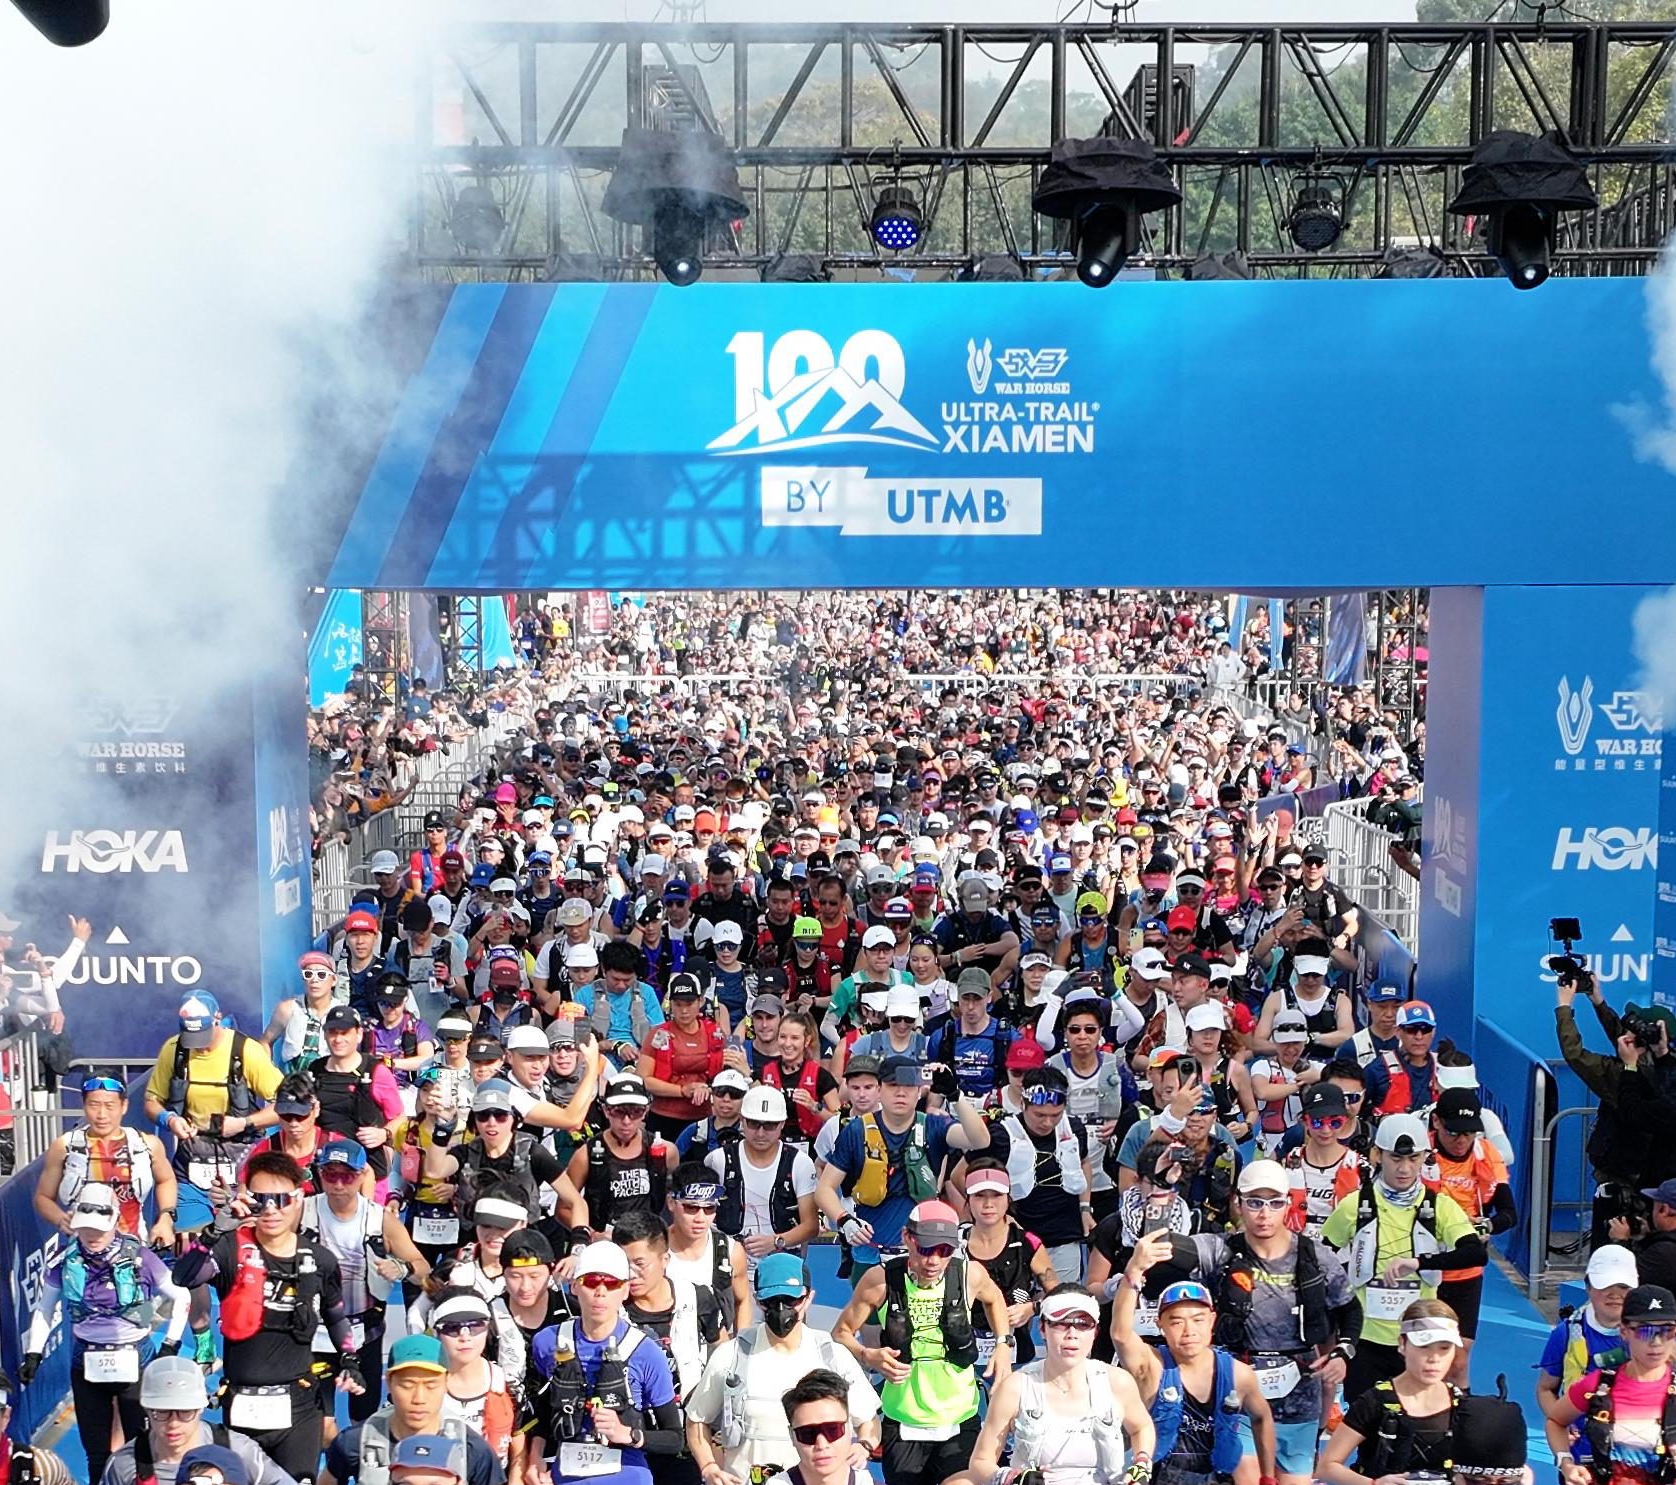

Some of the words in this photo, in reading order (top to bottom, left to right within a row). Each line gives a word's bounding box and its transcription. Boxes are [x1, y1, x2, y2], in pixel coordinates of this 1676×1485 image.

[994, 383, 1023, 395] WAR
[1025, 382, 1071, 395] HORSE
[942, 424, 1095, 453] XIAMEN
[786, 479, 832, 513] BY
[119, 741, 186, 758] HORSE
[79, 761, 186, 774] 维生素饮料
[41, 829, 190, 874] HOKA
[619, 1170, 640, 1181] THE
[614, 1189, 640, 1199] FACE
[686, 1183, 717, 1199] Buff
[577, 1452, 603, 1464] 5117
